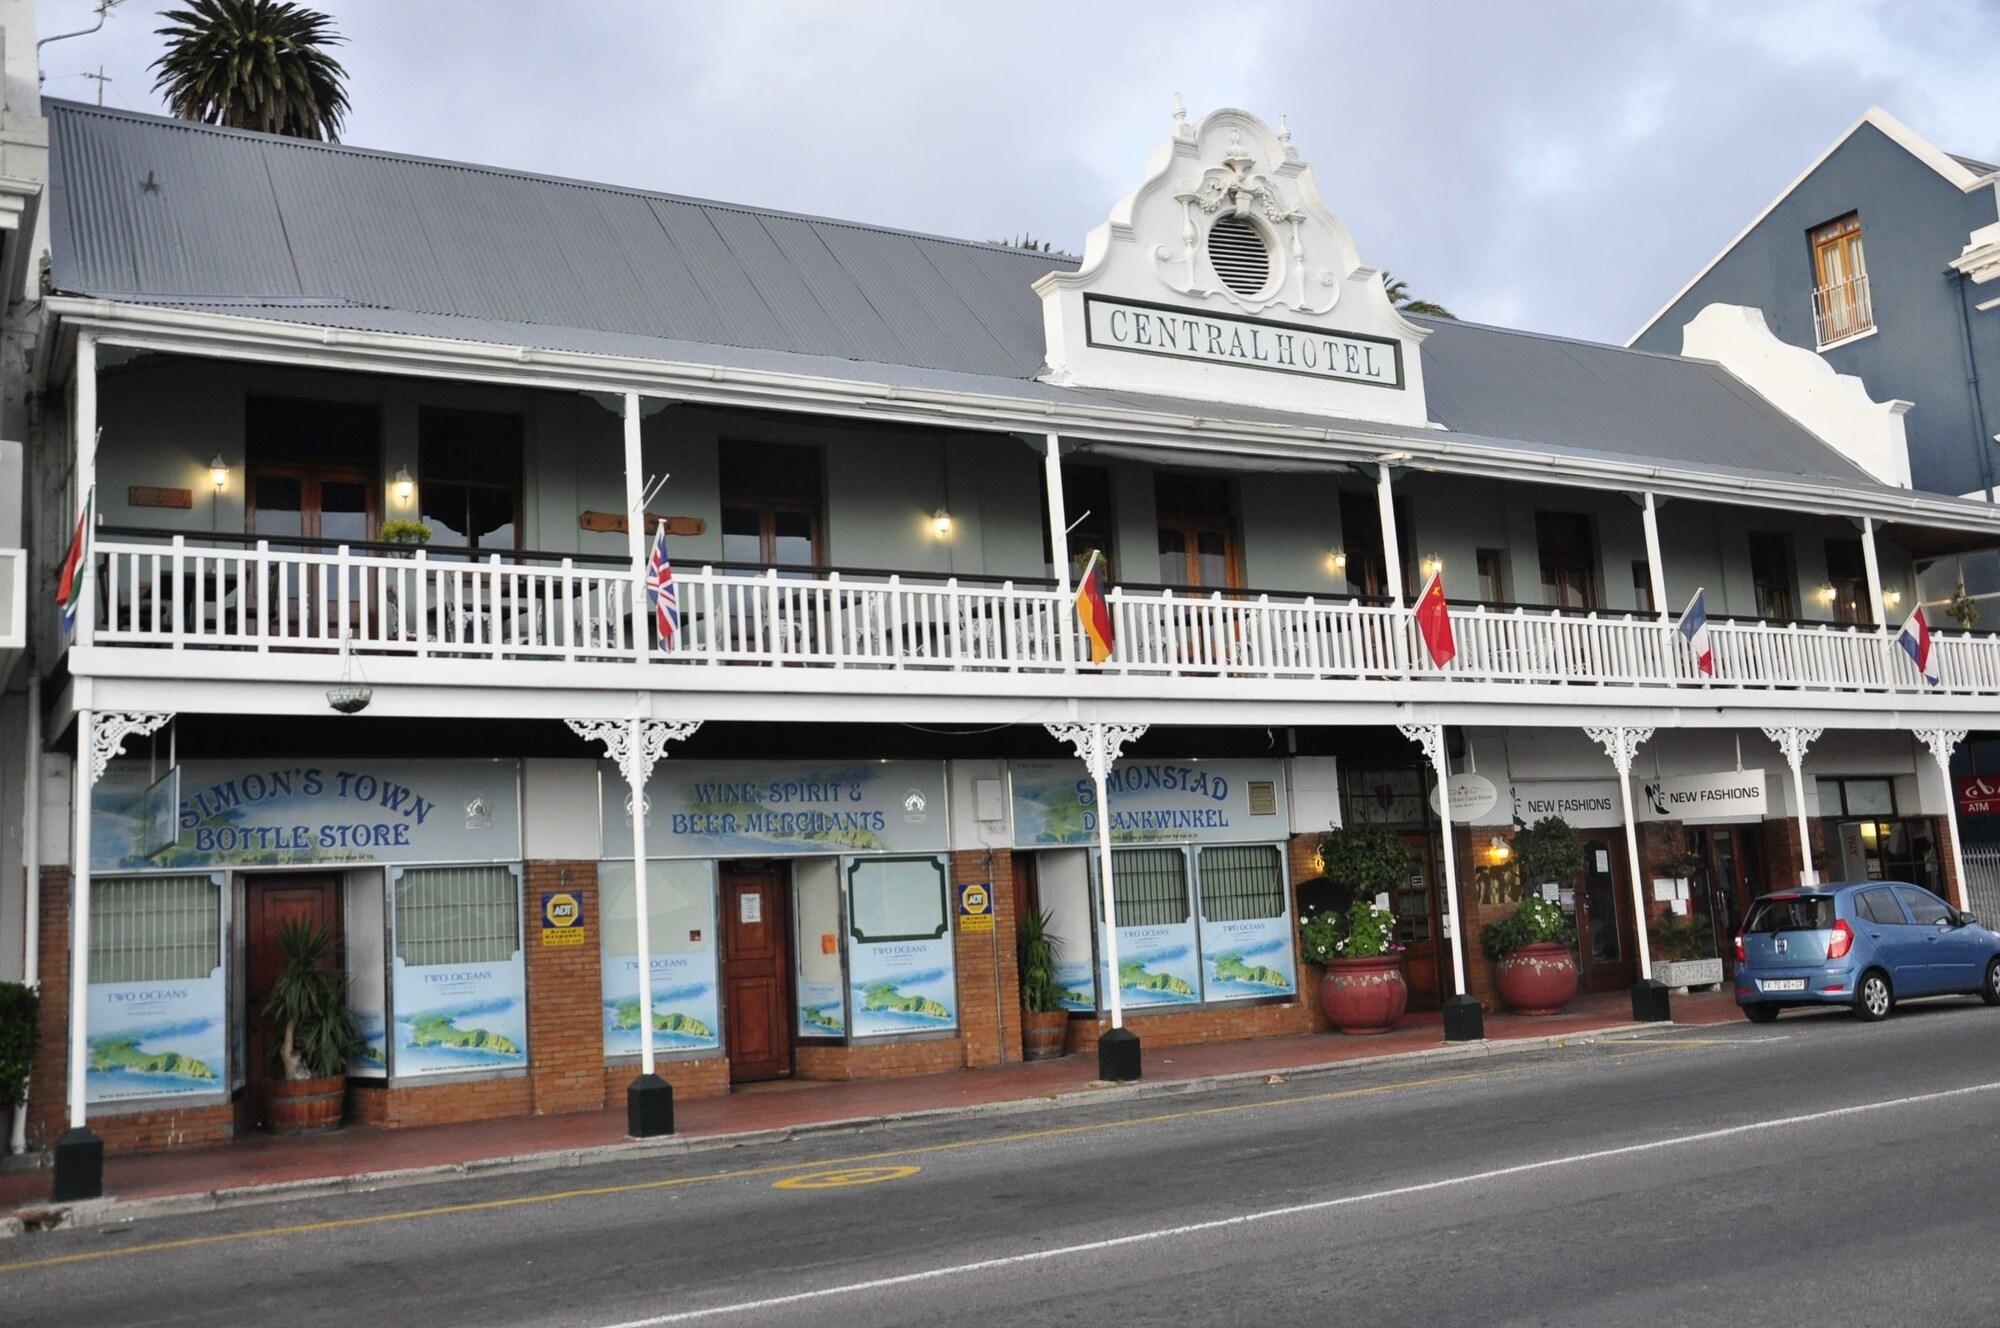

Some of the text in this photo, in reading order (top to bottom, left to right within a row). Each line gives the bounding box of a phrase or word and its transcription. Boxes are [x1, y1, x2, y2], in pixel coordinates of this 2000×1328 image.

[1111, 310, 1381, 377] CENTRAL HOTEL
[769, 782, 842, 803] SPIRIT
[849, 782, 862, 801] &
[1076, 765, 1229, 804] SMONSTAD
[180, 768, 435, 829] SIMON'S TOWN
[1670, 786, 1760, 804] NEW FASHIONS
[1528, 798, 1611, 813] NEW FASHIONS
[1968, 802, 1989, 812] ATM
[672, 810, 886, 834] BEER MERCHANTS
[1083, 808, 1230, 830] DANKWINKEL
[195, 823, 411, 851] BOTTLE STORE
[968, 894, 983, 904] ADT
[553, 904, 572, 916] ADT
[650, 959, 688, 969] OCEANS
[424, 970, 493, 983] TWO OCEANS
[106, 989, 188, 1003] TWO OCEANS
